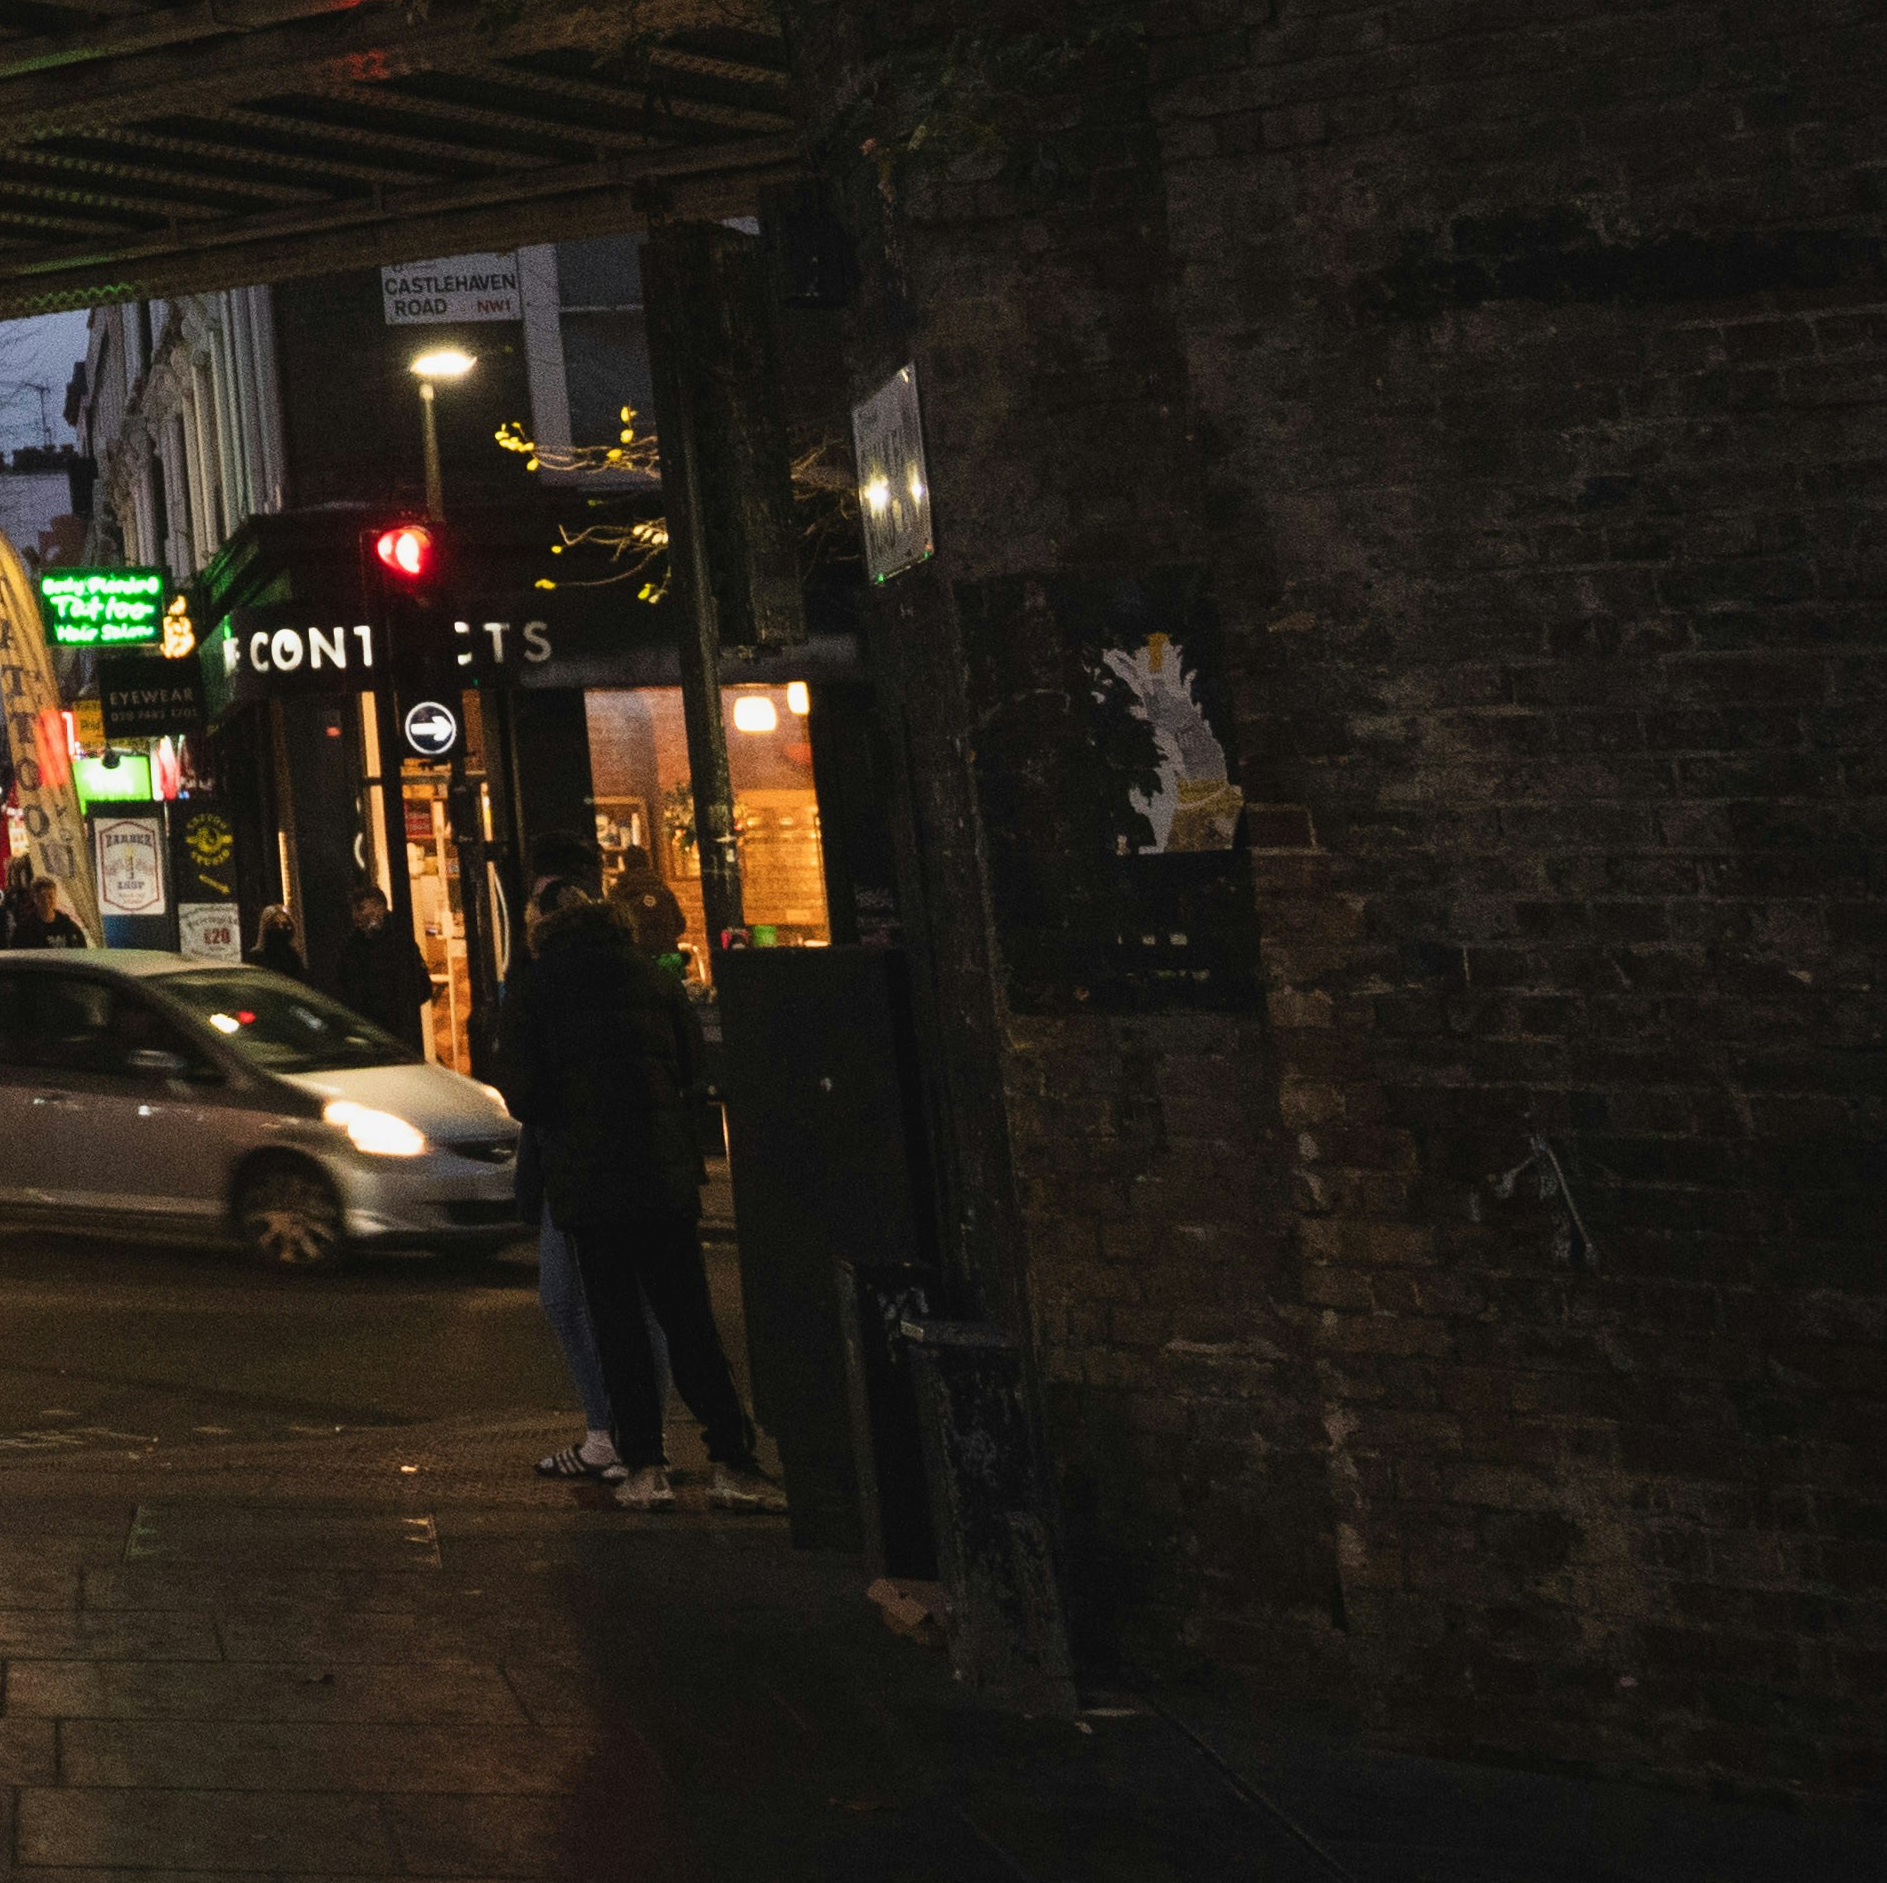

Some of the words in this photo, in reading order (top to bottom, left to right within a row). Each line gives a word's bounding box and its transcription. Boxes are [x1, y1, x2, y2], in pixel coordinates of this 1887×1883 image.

[384, 273, 516, 295] CASTLEHAVEN
[394, 298, 448, 316] ROAD
[476, 299, 511, 314] NW1
[248, 620, 553, 673] CONTTS
[109, 686, 194, 706] EYEWEAR
